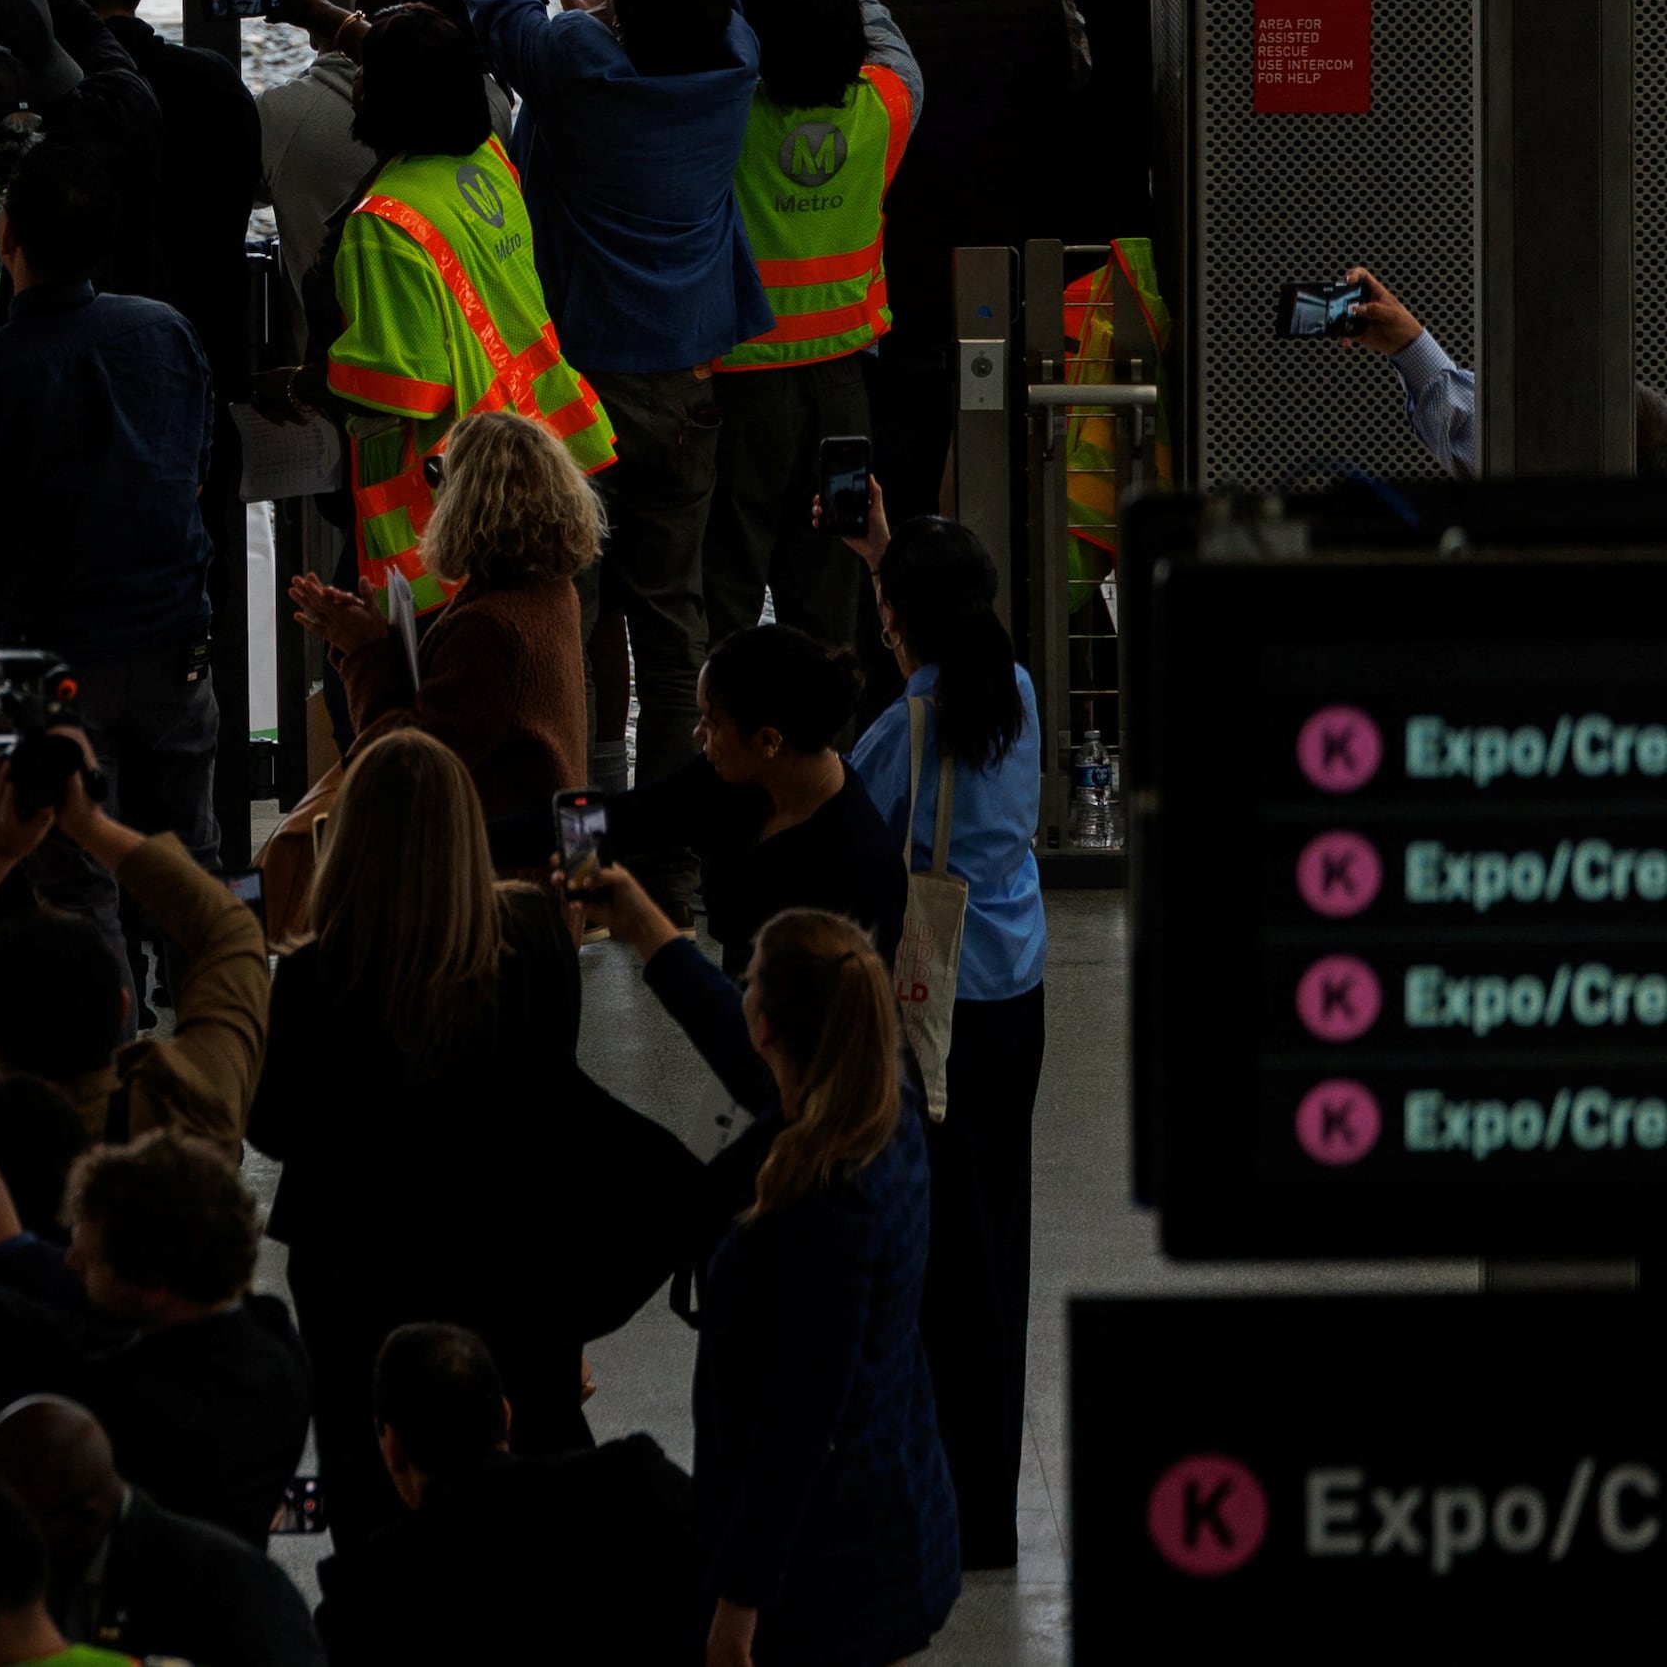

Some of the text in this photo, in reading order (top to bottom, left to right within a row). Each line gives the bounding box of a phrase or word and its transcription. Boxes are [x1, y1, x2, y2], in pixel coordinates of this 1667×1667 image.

[1259, 19, 1322, 30] AREA FOR
[1258, 32, 1319, 43] ASSISTED
[1258, 46, 1309, 57] RESCUE
[1258, 59, 1354, 70] USE INTERCOM
[1258, 73, 1321, 83] FOR HELP
[775, 191, 844, 214] Metro
[494, 232, 522, 263] Metro
[1183, 1455, 1660, 1575] K Expo/C
